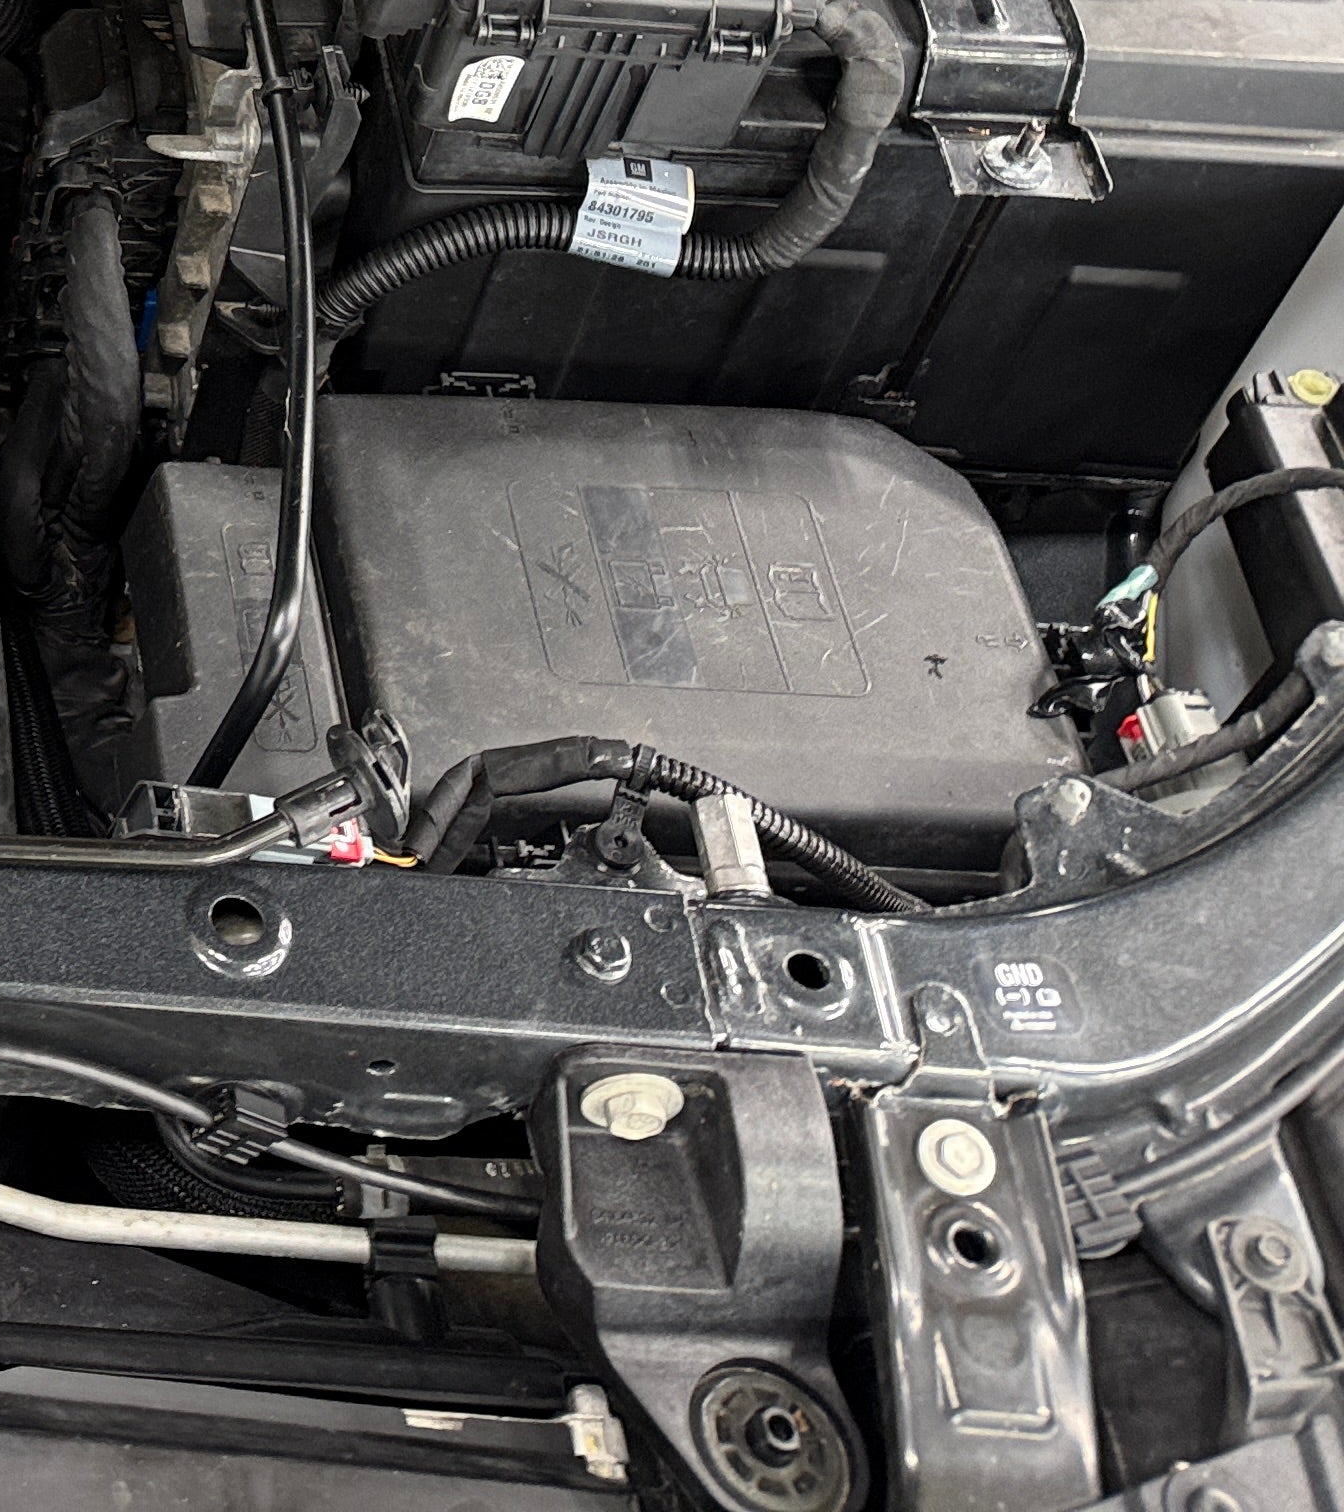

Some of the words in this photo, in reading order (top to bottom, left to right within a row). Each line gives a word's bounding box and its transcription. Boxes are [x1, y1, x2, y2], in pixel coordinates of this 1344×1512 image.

[588, 200, 656, 224] 84301795
[587, 228, 642, 248] JSRGH
[994, 962, 1044, 987] GND
